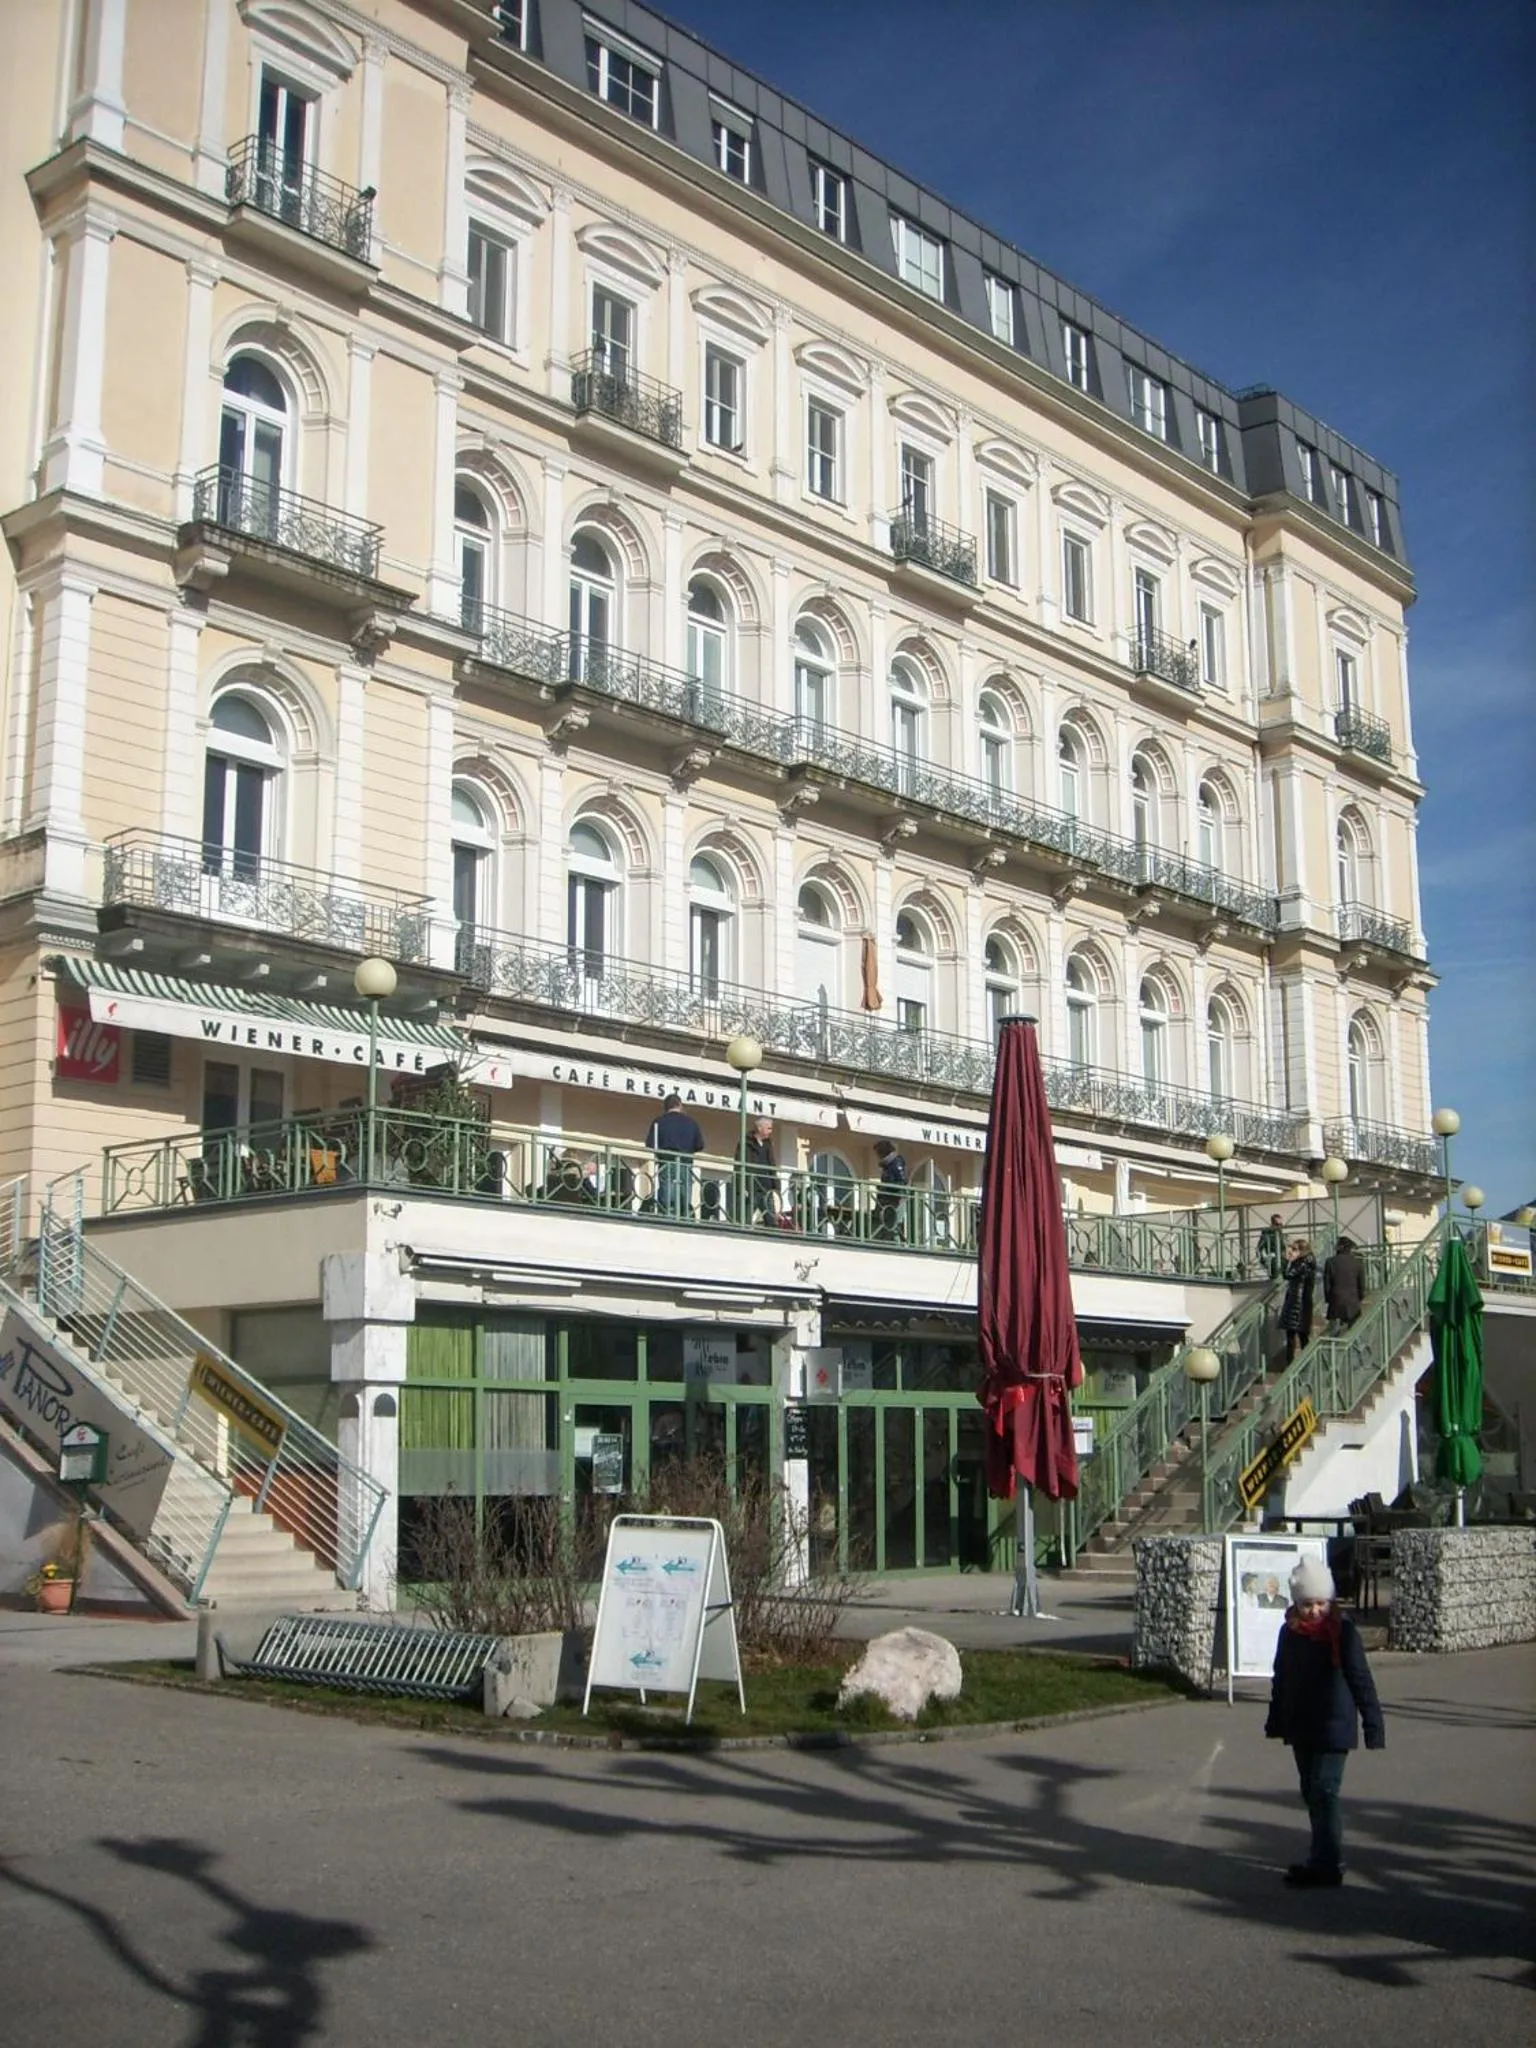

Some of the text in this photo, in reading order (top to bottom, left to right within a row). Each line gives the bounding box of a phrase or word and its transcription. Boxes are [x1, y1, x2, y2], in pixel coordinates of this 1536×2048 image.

[64, 1017, 118, 1074] illy
[552, 1065, 610, 1088] CAFÉ
[14, 1336, 76, 1438] PANOR
